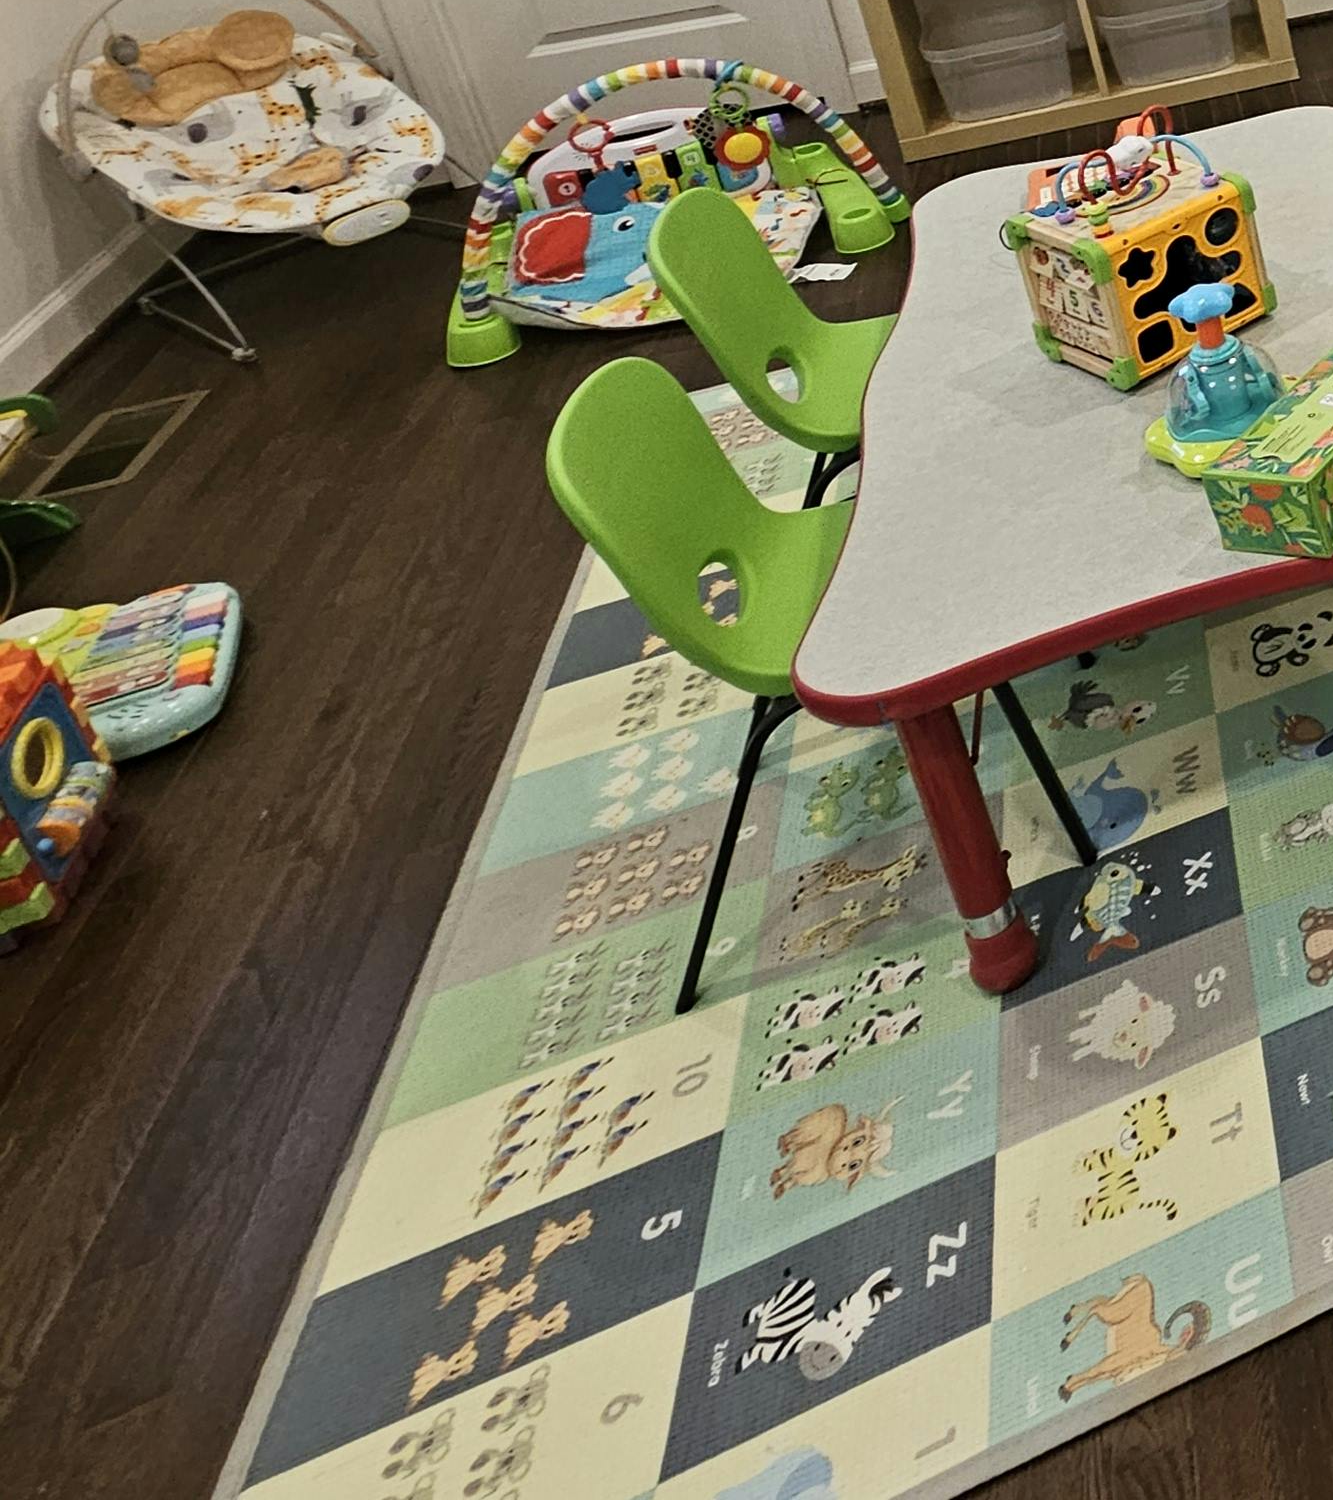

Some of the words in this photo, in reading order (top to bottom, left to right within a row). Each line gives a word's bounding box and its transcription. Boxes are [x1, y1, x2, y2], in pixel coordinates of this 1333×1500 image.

[1069, 289, 1079, 307] 5
[1165, 664, 1191, 695] Vv
[1172, 745, 1200, 794] Ww
[1182, 850, 1214, 896] Xx
[1194, 966, 1226, 1009] Ss
[672, 1053, 713, 1098] 10
[927, 1069, 975, 1121] Yy
[1297, 1072, 1311, 1106] Newt
[1209, 1101, 1244, 1145] Tt
[641, 1208, 684, 1242] 5
[925, 1220, 968, 1289] Zz
[1224, 1253, 1264, 1329] Uu
[707, 1339, 730, 1388] Zebra
